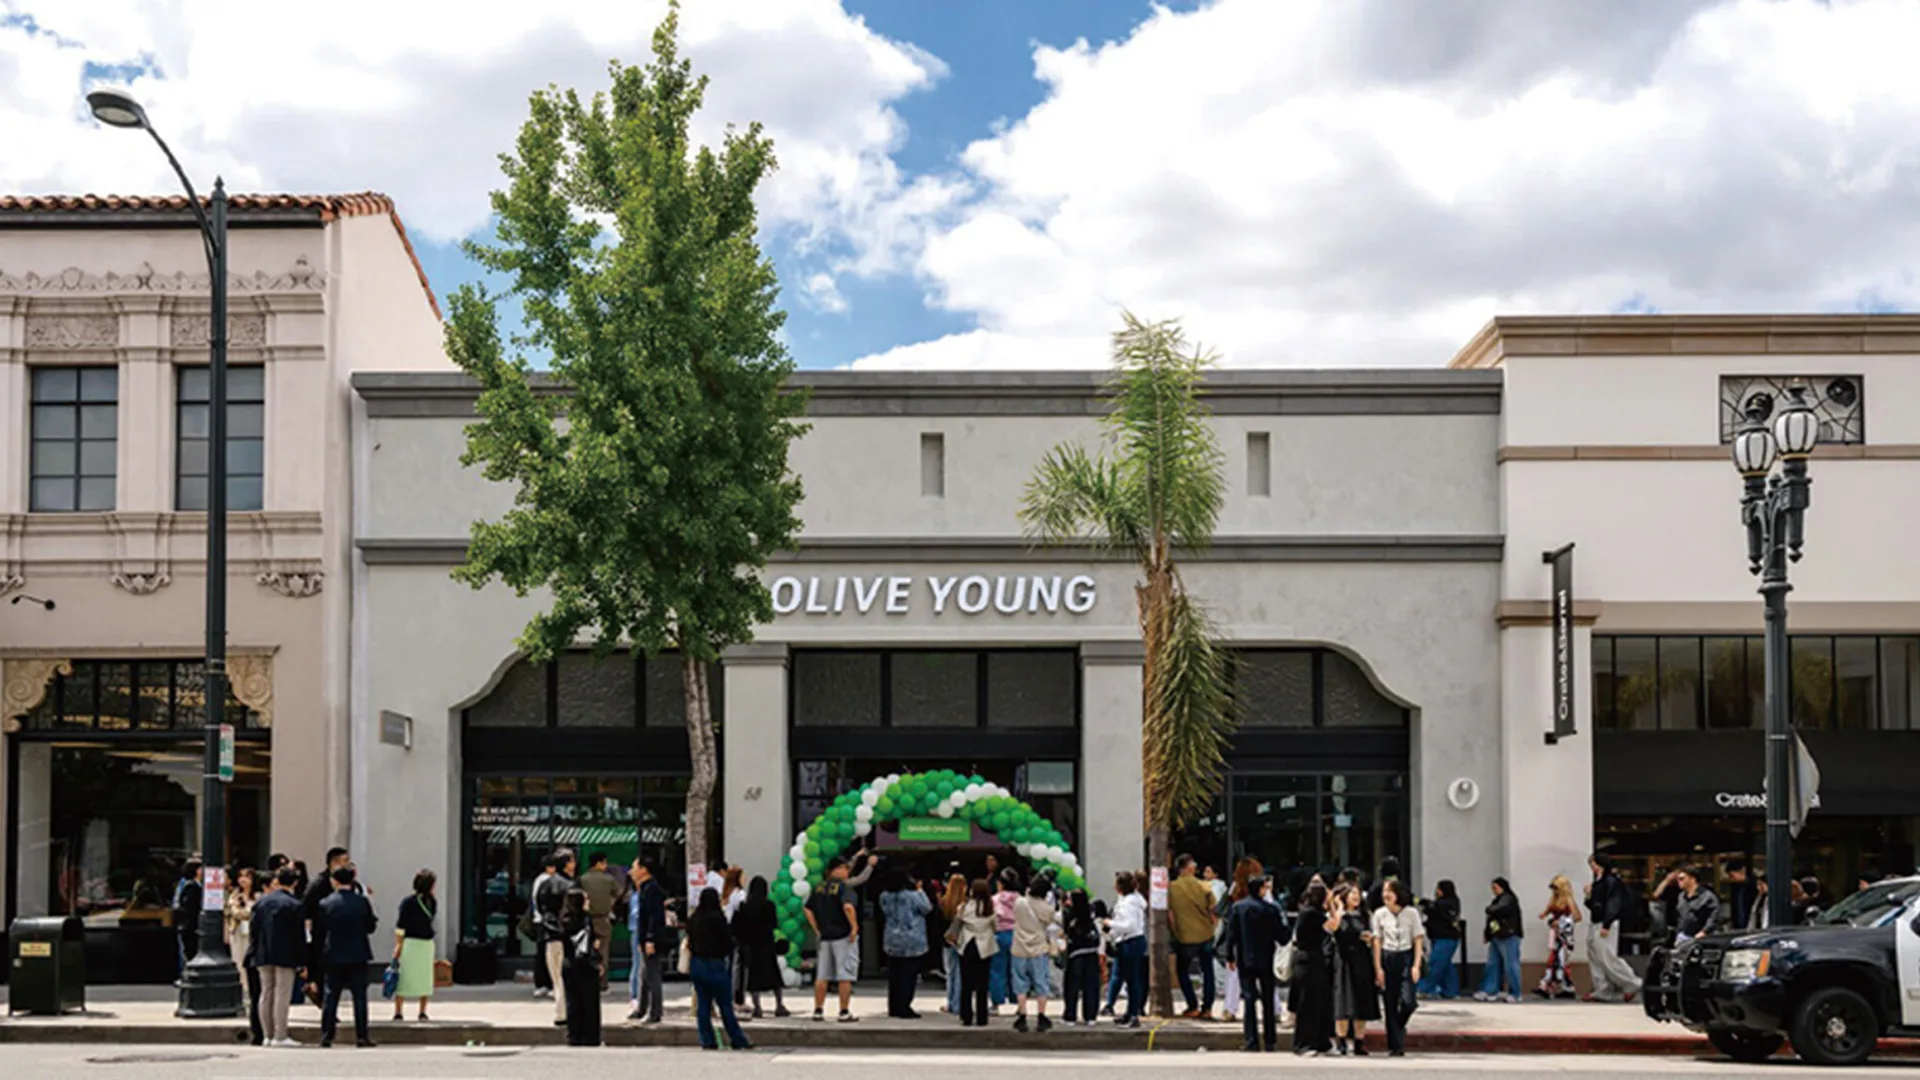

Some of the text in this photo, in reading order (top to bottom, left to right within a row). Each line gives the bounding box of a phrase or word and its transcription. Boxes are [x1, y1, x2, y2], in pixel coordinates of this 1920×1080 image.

[770, 575, 1096, 613] OLIVE YOUNG
[1557, 589, 1569, 720] Crate&Barrel
